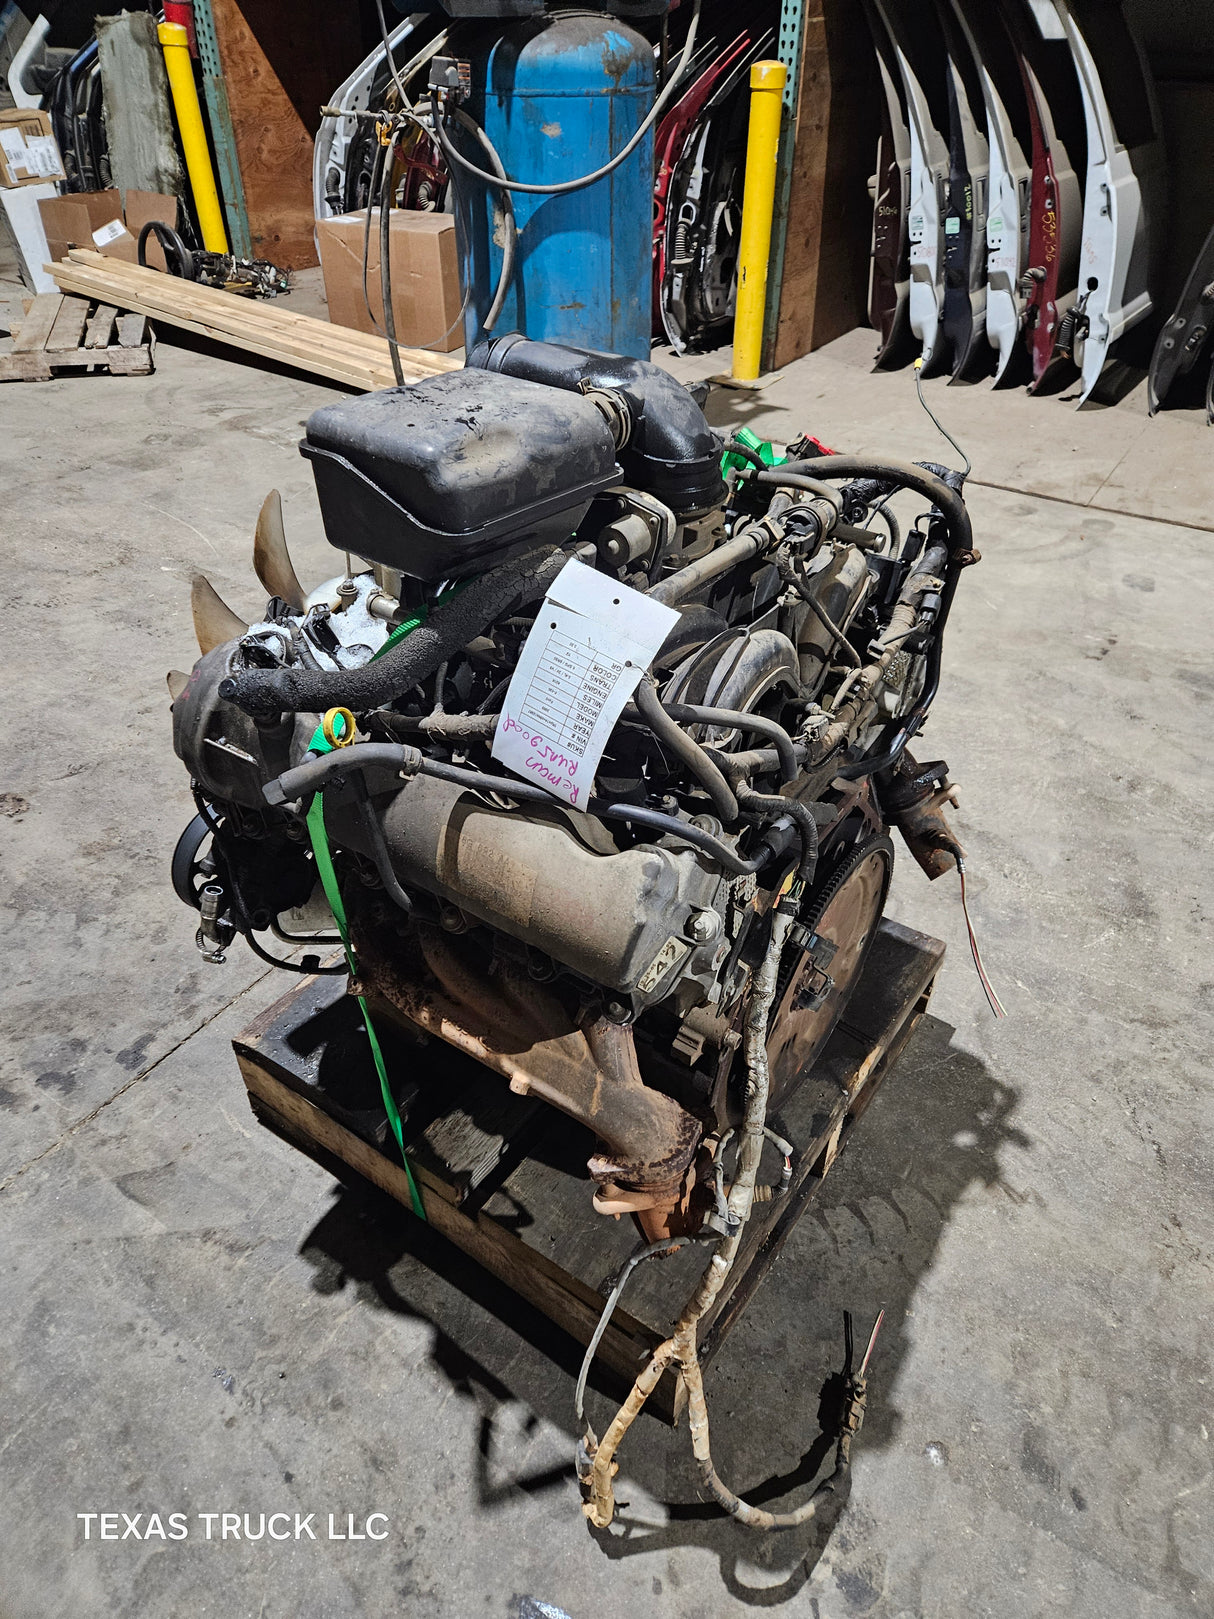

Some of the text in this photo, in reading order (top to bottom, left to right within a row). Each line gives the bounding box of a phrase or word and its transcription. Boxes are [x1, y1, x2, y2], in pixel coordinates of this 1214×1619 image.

[593, 664, 617, 681] COLOR
[611, 663, 622, 672] GR
[590, 674, 612, 690] TRANS
[583, 682, 607, 699] ENGINE
[582, 694, 602, 709] MILES
[576, 702, 598, 718] MODEL
[575, 713, 594, 728] MAKE
[573, 723, 590, 737] YEAR
[576, 737, 587, 745] VIN
[525, 756, 579, 804] Reman
[643, 944, 676, 991] 542
